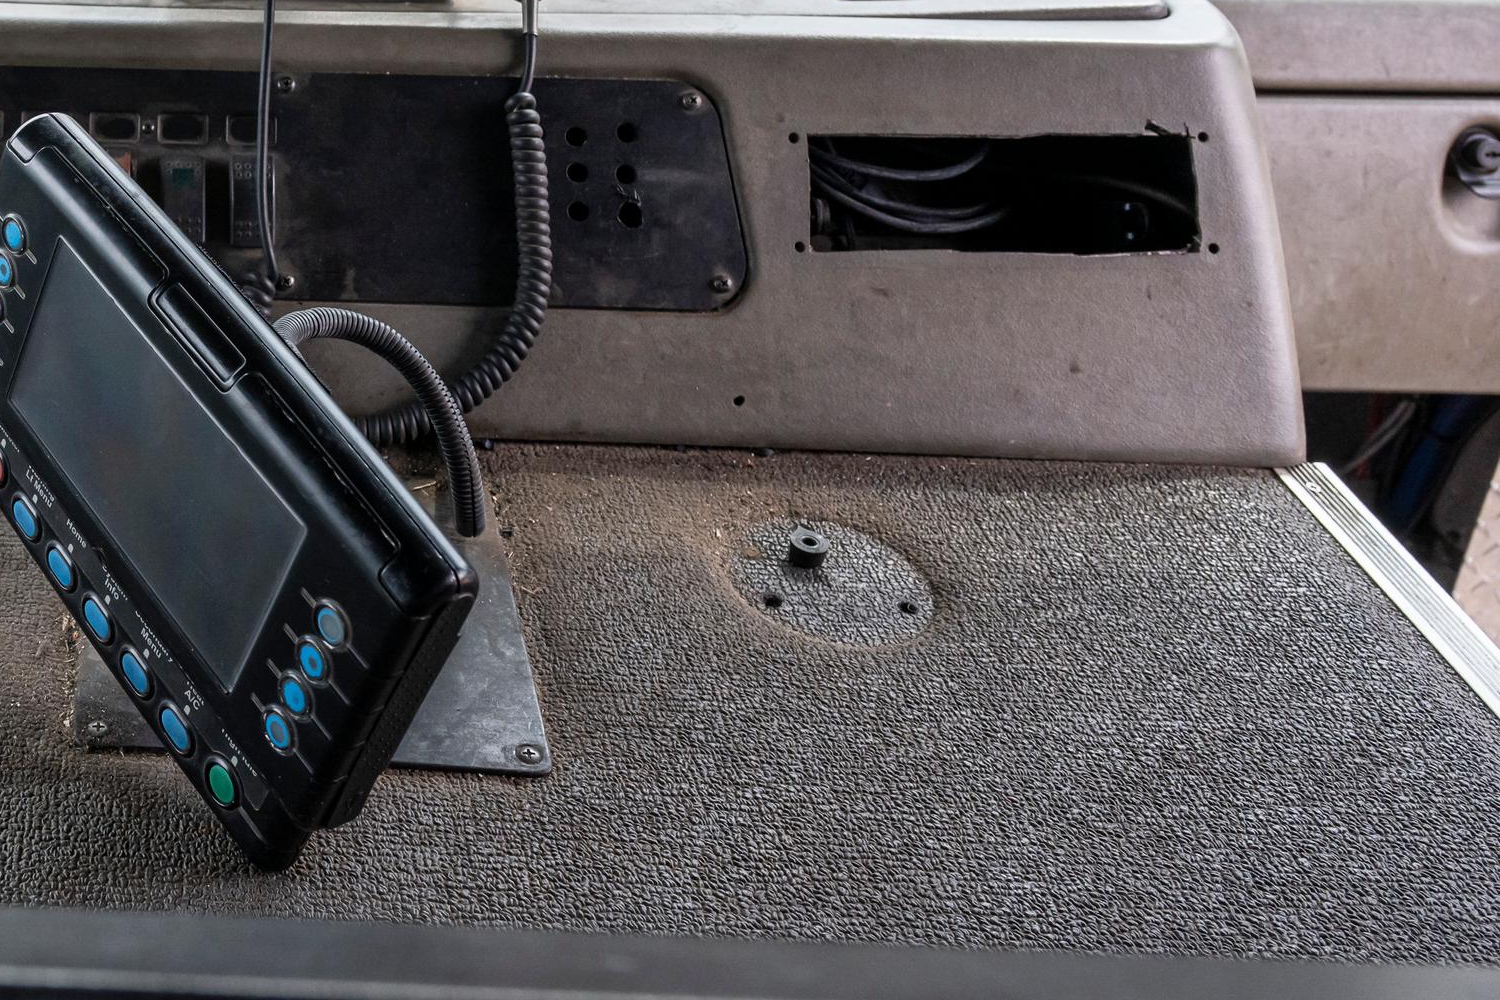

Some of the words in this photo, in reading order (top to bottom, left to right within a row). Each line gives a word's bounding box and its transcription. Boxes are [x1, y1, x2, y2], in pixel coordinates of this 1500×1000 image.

[33, 480, 54, 509] Menu
[66, 517, 88, 549] Home
[103, 577, 121, 601] Info
[140, 626, 164, 660] Menu
[183, 689, 201, 712] A/C
